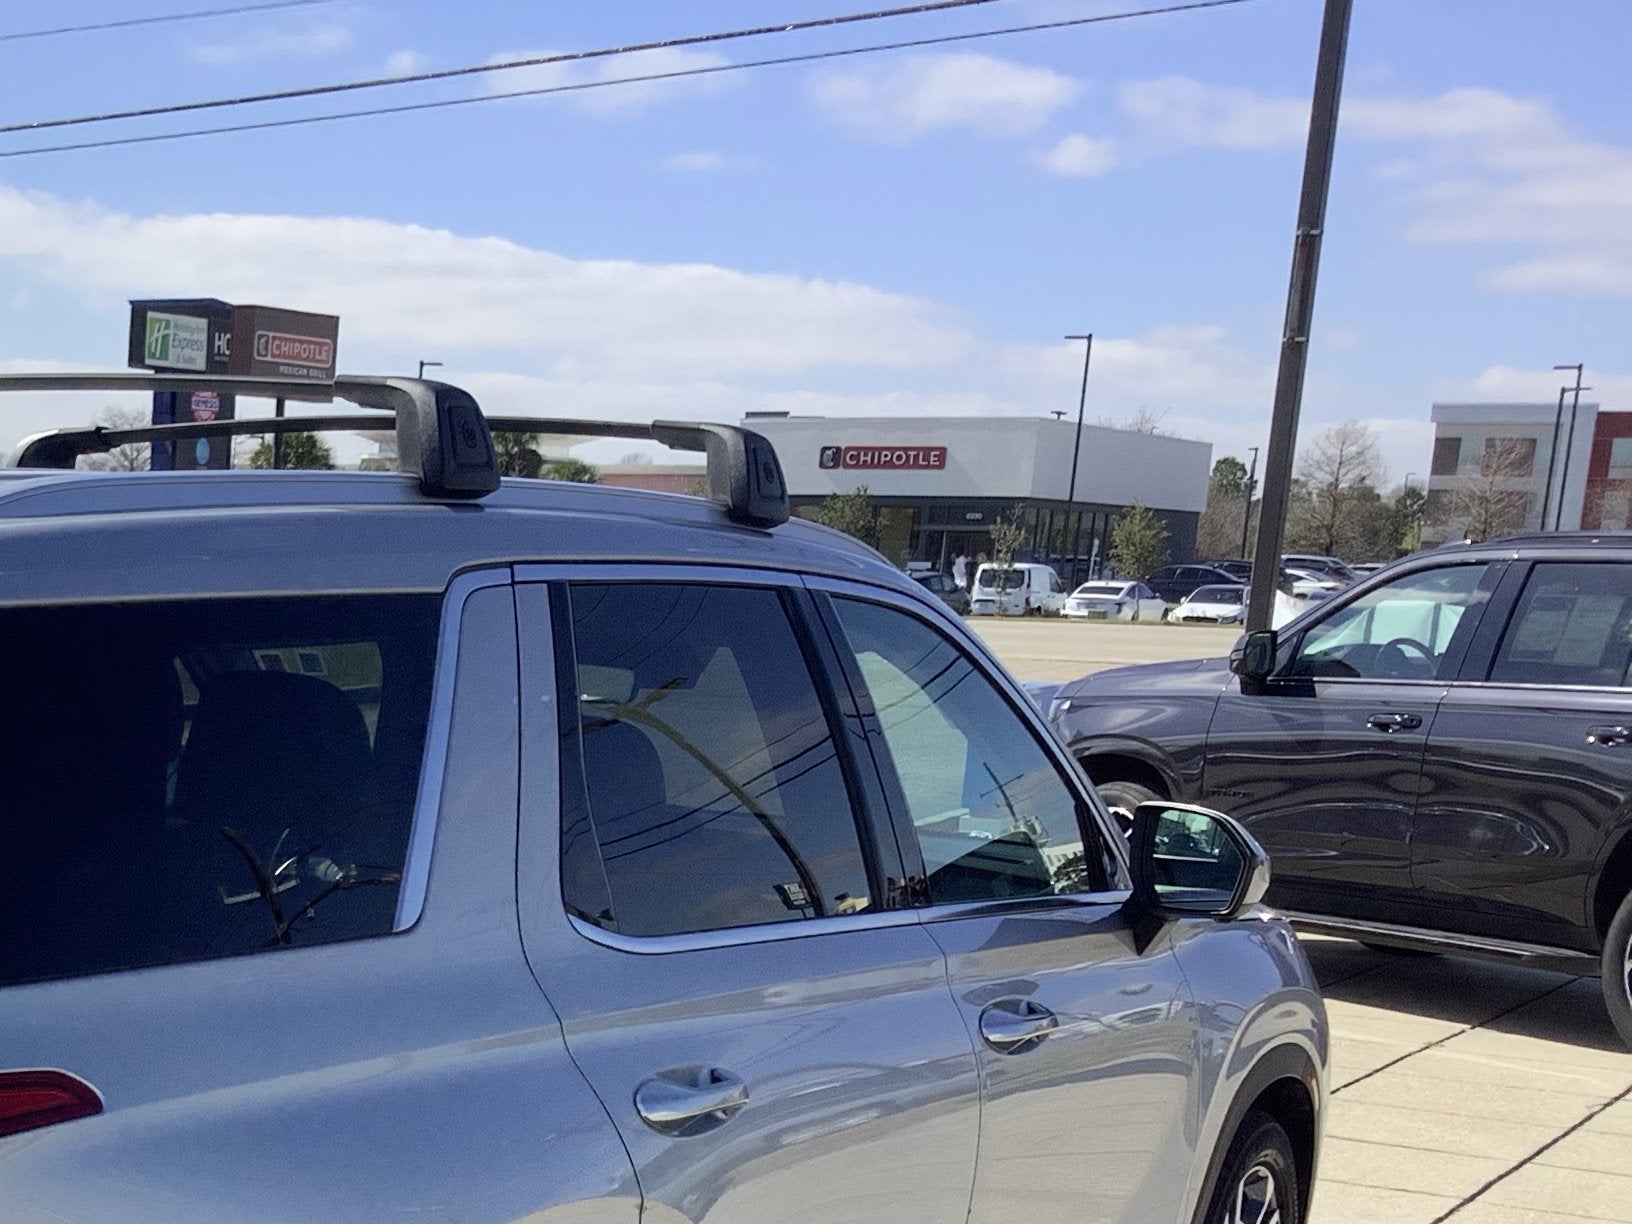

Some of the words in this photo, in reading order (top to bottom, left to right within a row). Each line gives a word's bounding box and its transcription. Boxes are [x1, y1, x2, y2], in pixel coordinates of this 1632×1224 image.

[171, 333, 204, 352] Express
[272, 341, 329, 360] CHIPOTLE
[846, 451, 940, 465] CHIPOTLE
